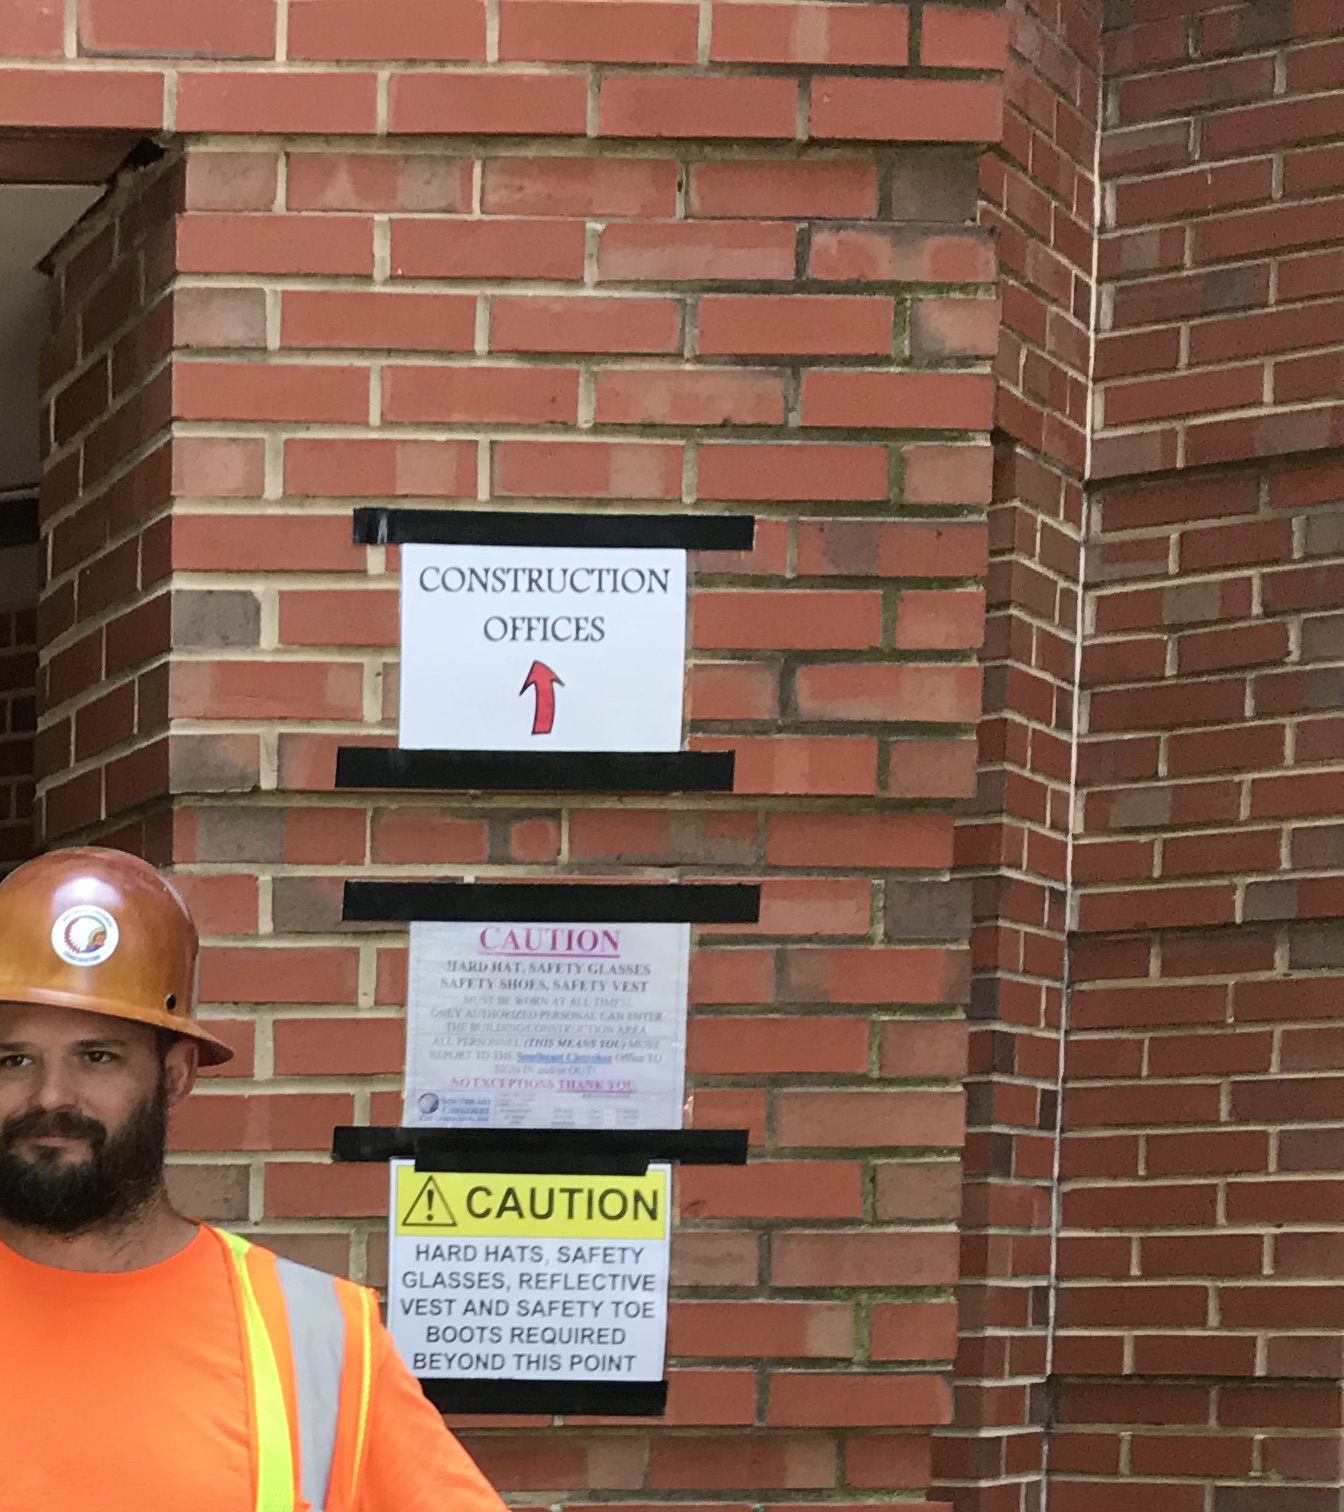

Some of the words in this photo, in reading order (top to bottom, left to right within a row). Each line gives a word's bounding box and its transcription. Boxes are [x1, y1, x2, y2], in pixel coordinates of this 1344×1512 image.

[418, 566, 671, 595] CONSTRUCTION
[483, 615, 605, 642] OFFICES
[478, 926, 620, 952] CAUTION
[446, 959, 489, 973] HARD
[527, 961, 583, 975] SAFETY
[586, 962, 651, 976] GLASSES
[440, 976, 495, 990] SAFETY
[552, 979, 606, 992] SAFETY
[612, 980, 648, 993] VEST
[570, 997, 590, 1007] ALL
[464, 1008, 538, 1020] AUTHORIZED
[466, 1186, 659, 1221] CAUTION
[415, 1244, 478, 1262] HARD
[484, 1244, 551, 1266] HATS,
[557, 1245, 646, 1265] SAFETY
[401, 1271, 512, 1295] GLASSES,
[519, 1272, 656, 1292] REFLECTIVE
[400, 1298, 457, 1317] VEST
[462, 1298, 510, 1317] AND
[516, 1299, 602, 1318] SAFETY
[611, 1300, 656, 1319] TOE
[426, 1325, 503, 1344] BOOTS
[511, 1327, 626, 1347] REQUIRED
[413, 1352, 507, 1372] BEYOND
[514, 1353, 562, 1372] THIS
[569, 1354, 638, 1373] POINT
